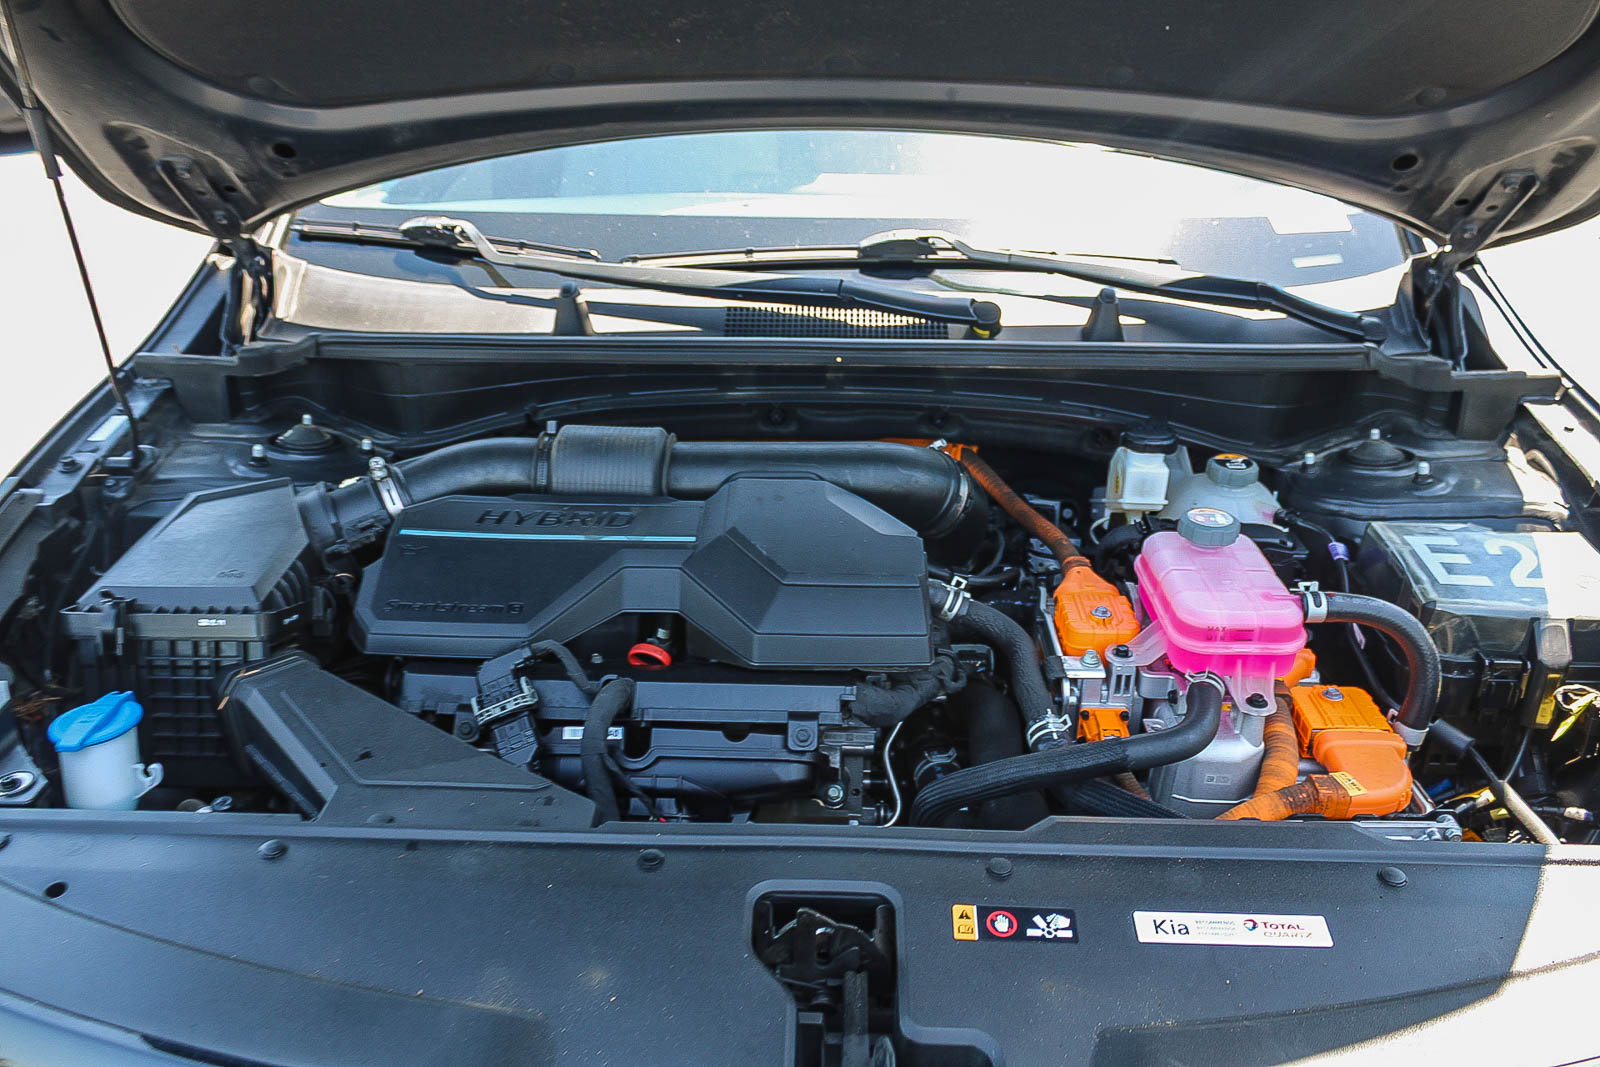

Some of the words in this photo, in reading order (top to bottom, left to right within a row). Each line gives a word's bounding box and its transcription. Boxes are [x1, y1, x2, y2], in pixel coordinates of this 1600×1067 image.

[475, 509, 637, 528] HYBRID
[383, 599, 504, 613] Smartstream
[1152, 919, 1190, 936] Kia
[1261, 921, 1305, 931] TOTAL
